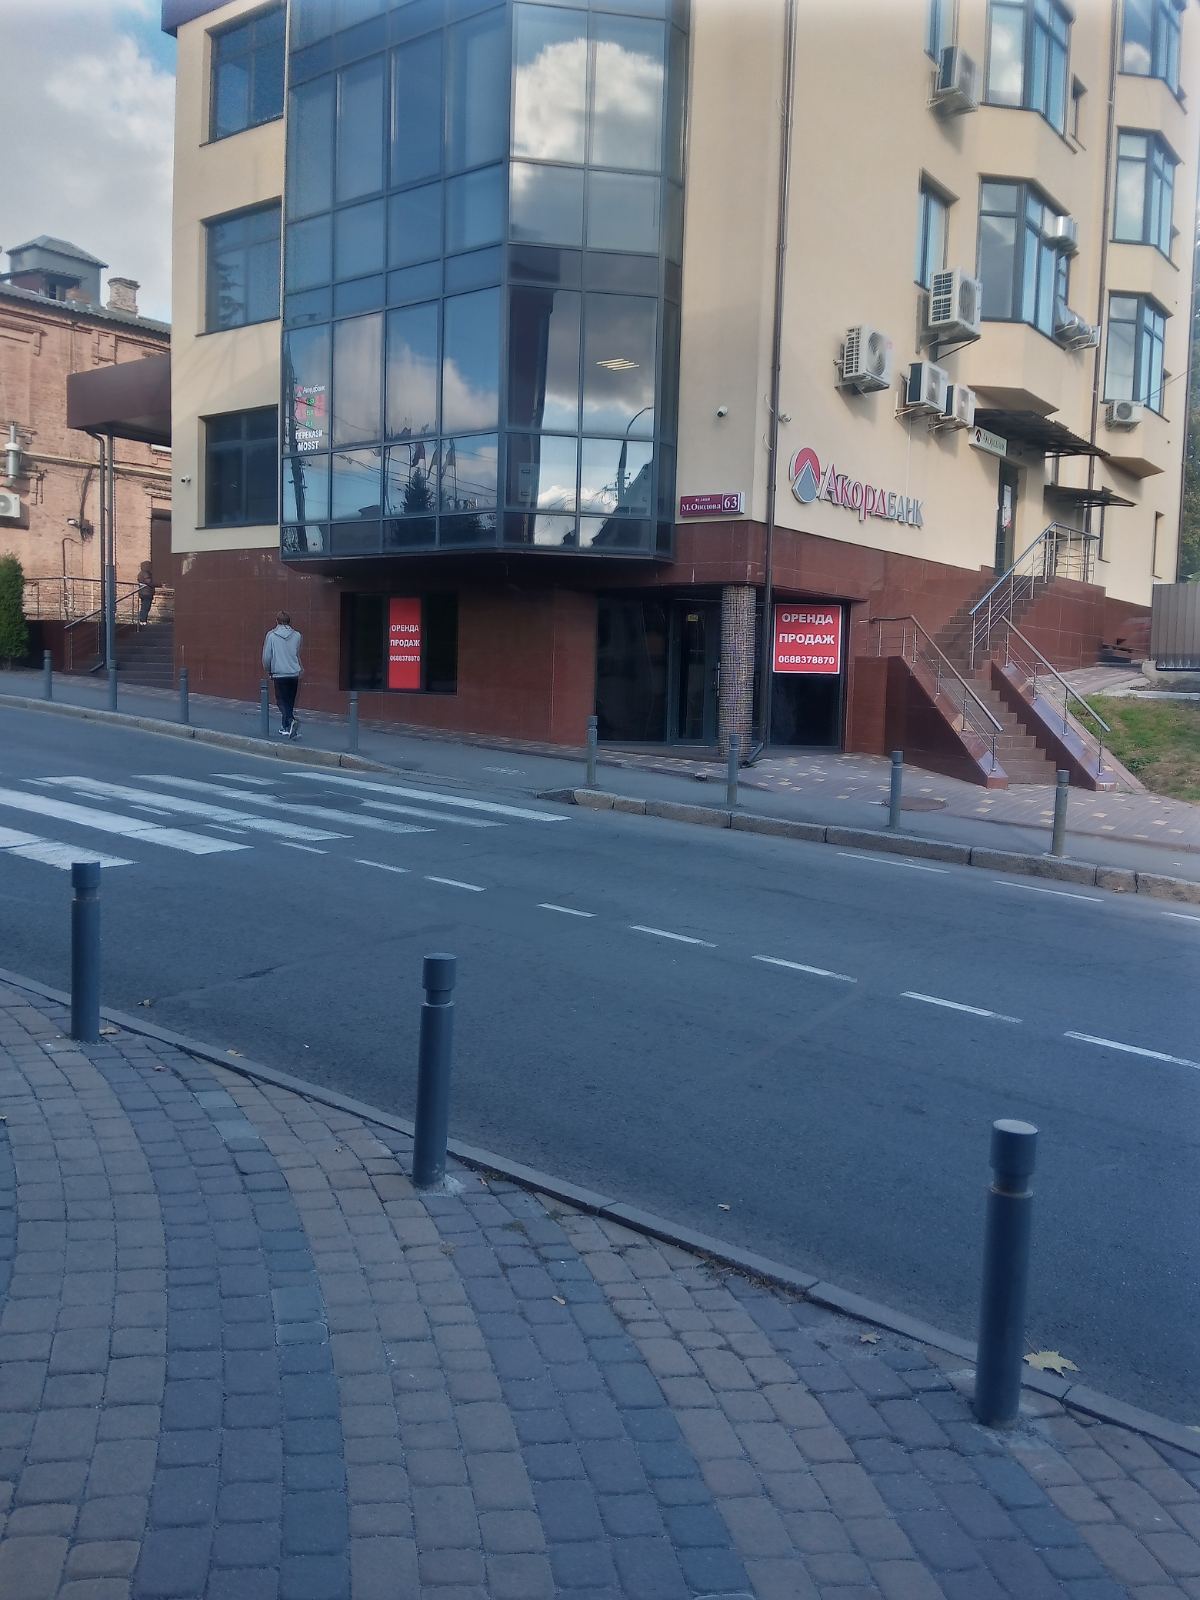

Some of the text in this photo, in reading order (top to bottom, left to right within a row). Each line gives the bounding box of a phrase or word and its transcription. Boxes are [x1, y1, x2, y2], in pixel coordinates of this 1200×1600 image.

[724, 496, 738, 509] 63
[781, 613, 834, 625] ОРЕНДА
[391, 624, 420, 632] ОРЕНДА
[390, 639, 420, 648] ПРОДАЖ
[779, 633, 835, 646] ПРОДАЖ
